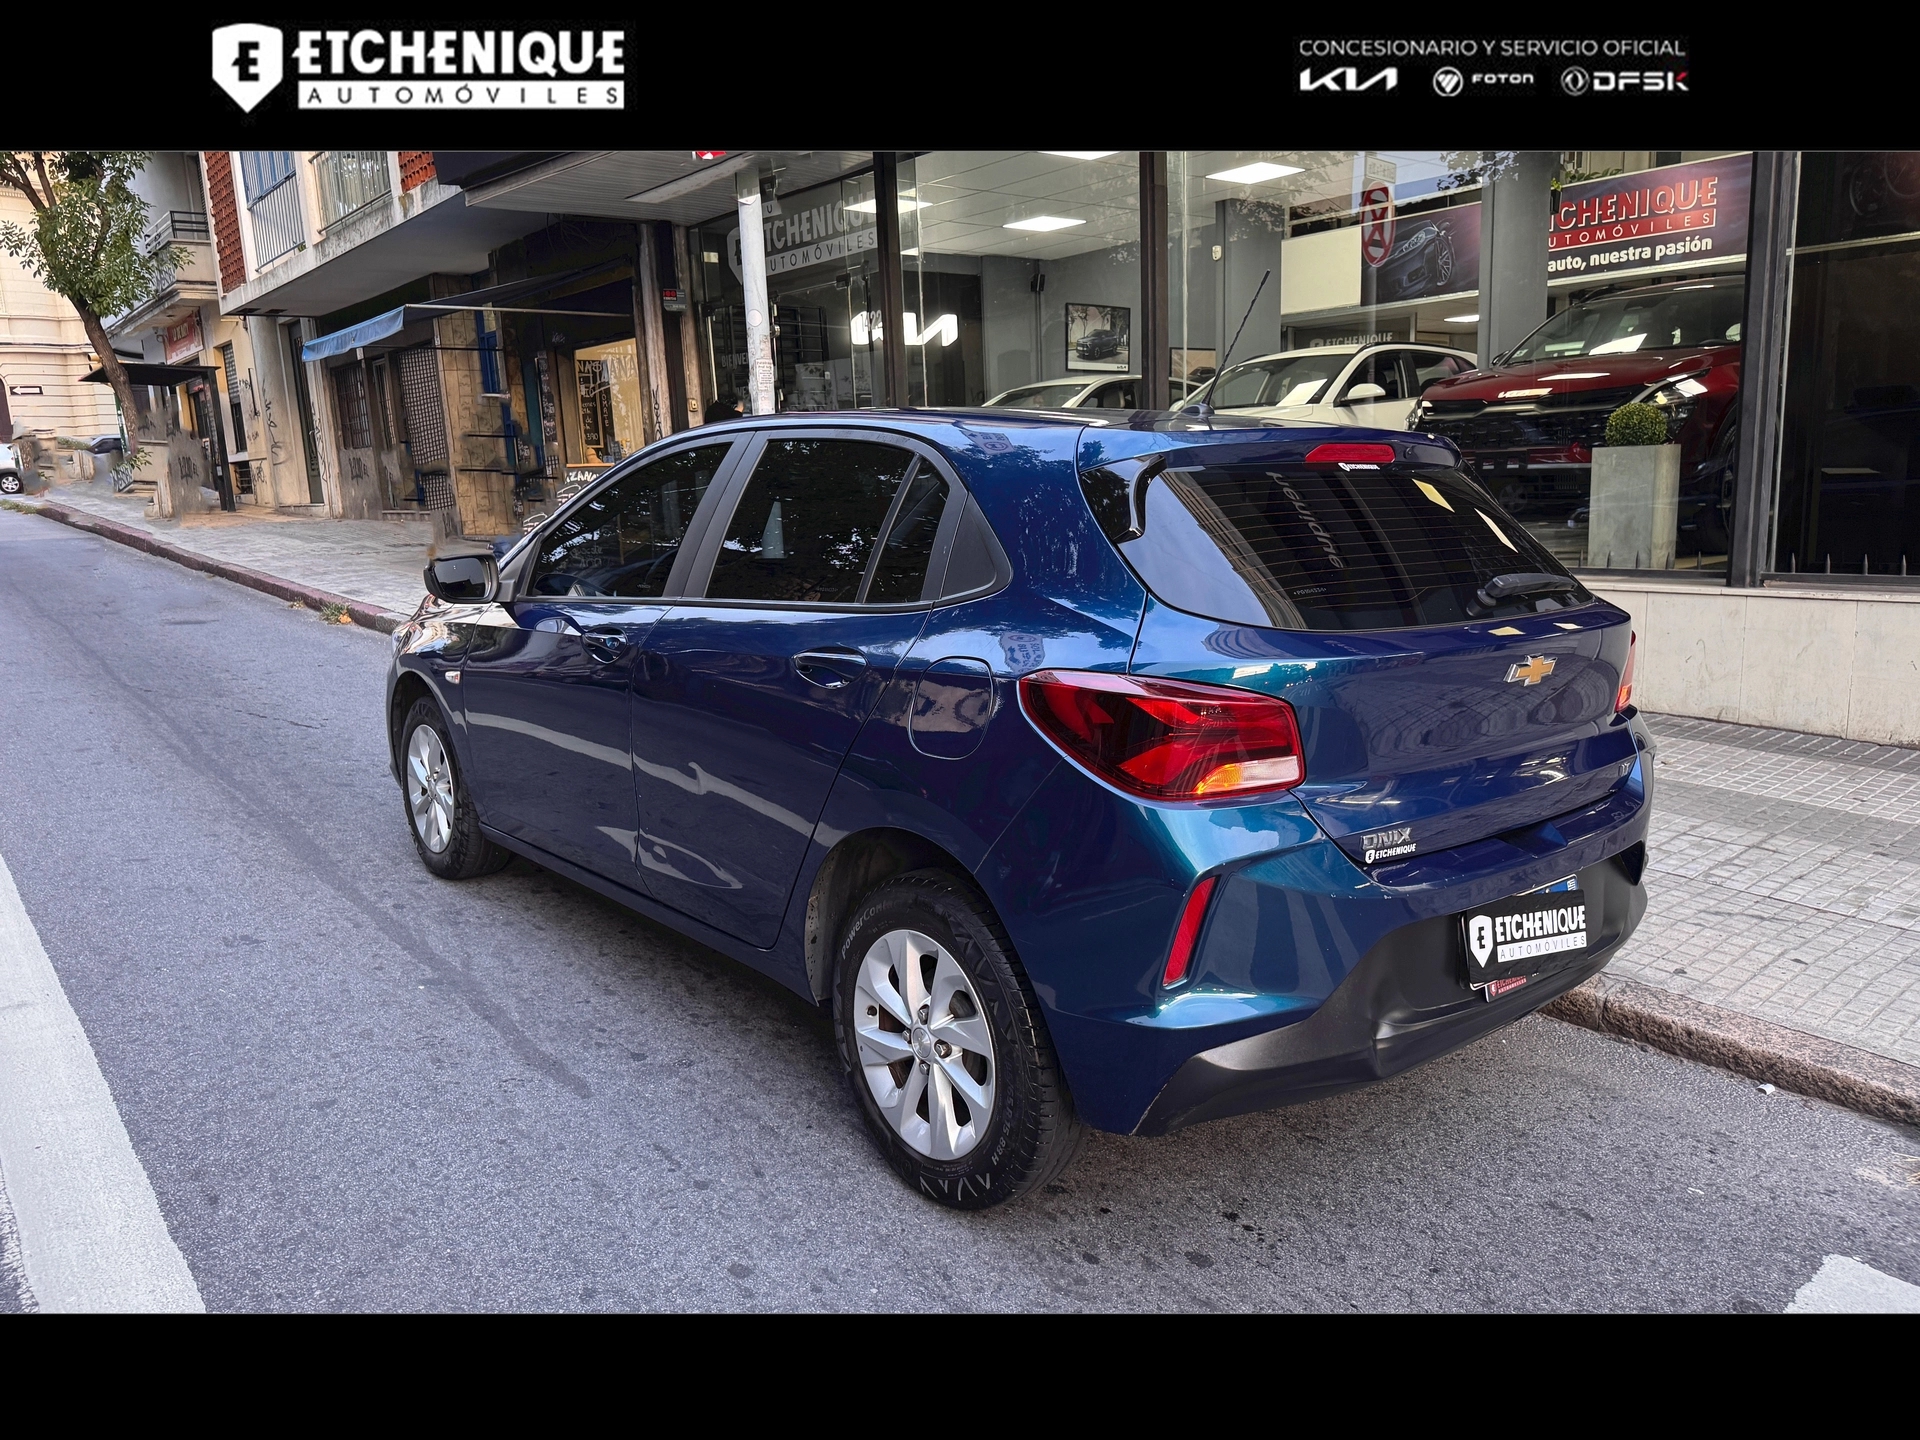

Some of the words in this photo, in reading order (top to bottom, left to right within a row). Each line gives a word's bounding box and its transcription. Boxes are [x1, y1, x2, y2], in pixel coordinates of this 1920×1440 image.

[763, 190, 877, 252] TCHENIQUE
[1549, 176, 1718, 231] CHENIQUE
[1548, 212, 1710, 248] UTOMÓVILES
[770, 231, 875, 271] UTOMÓVILES
[1547, 255, 1586, 272] auto,
[1590, 246, 1652, 266] nuestra
[1655, 235, 1712, 261] pasión
[1360, 827, 1411, 850] ONIX
[1375, 843, 1417, 860] ETCHENIQUE
[1495, 905, 1586, 943] ETCHENIQUE
[1500, 935, 1585, 960] AUTOMÓVILES
